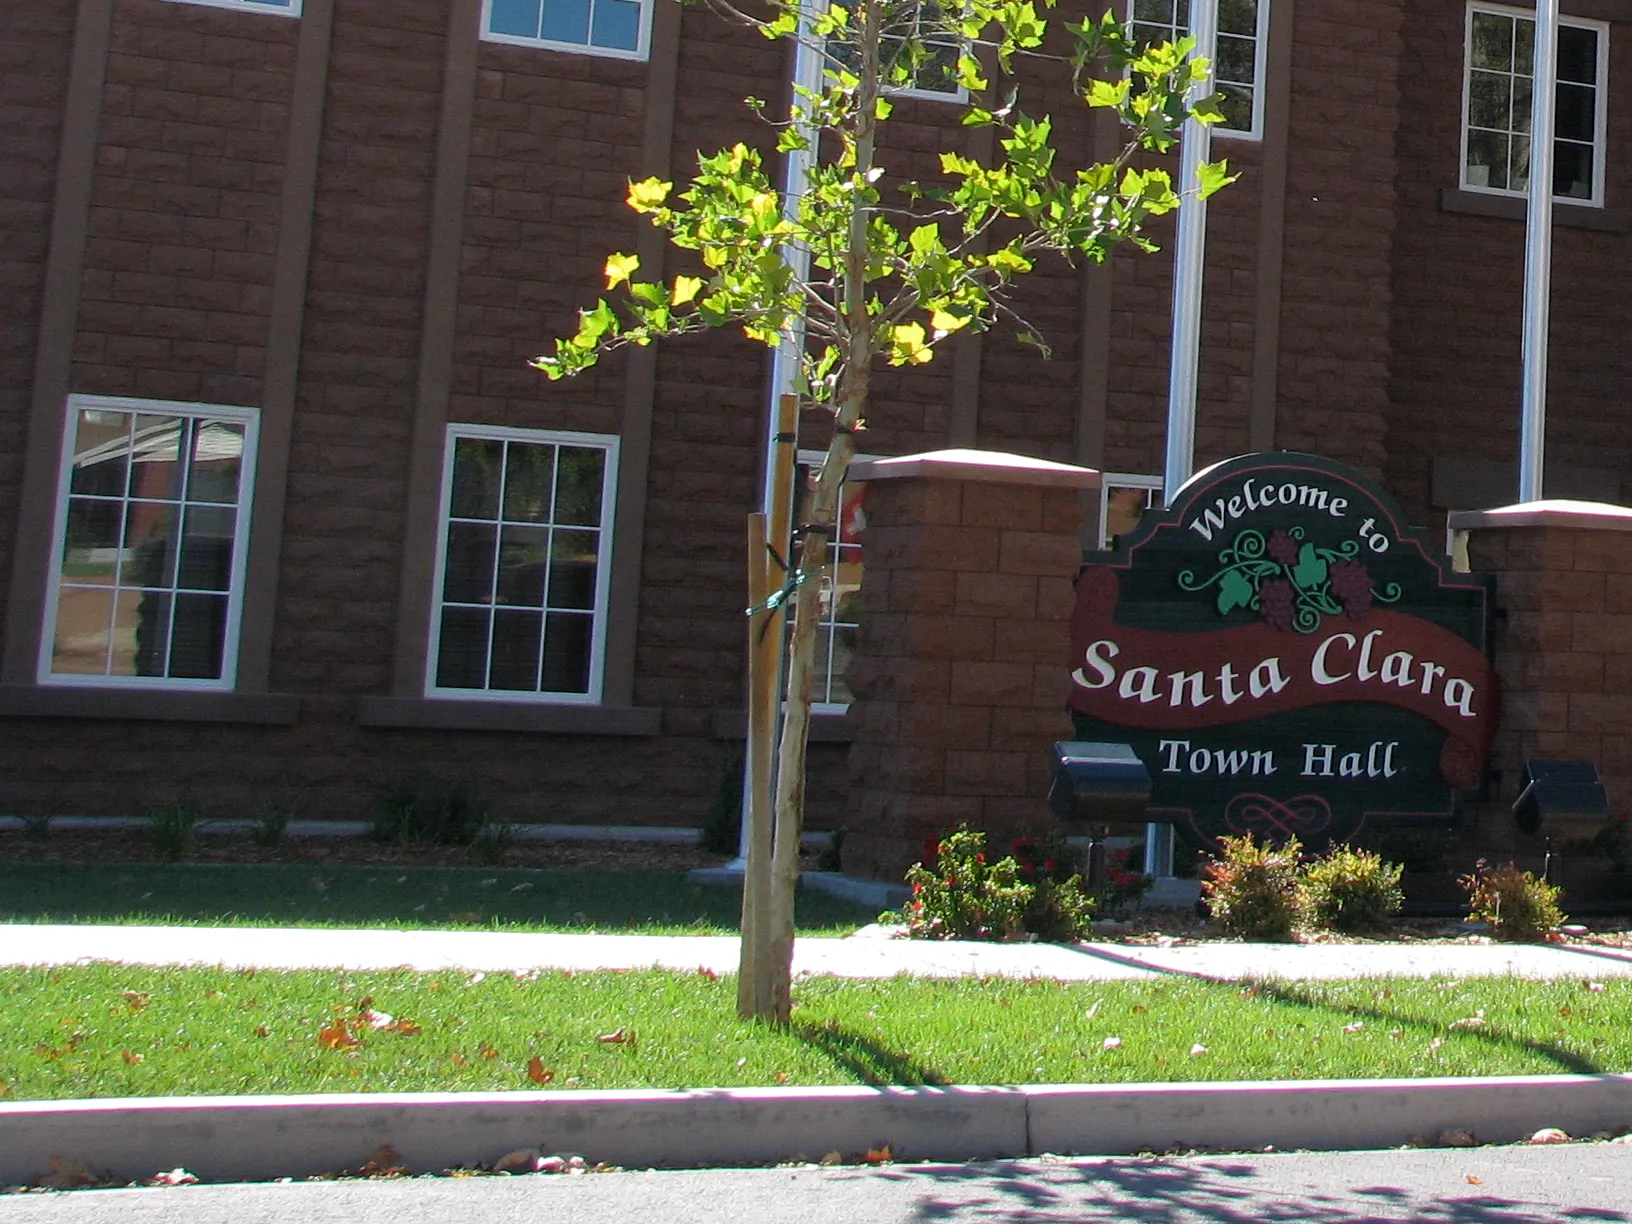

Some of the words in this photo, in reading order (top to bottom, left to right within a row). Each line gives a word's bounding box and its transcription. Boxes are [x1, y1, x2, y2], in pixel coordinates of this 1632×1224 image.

[1188, 478, 1349, 542] Welcome
[1357, 517, 1390, 554] to
[1071, 639, 1292, 708] Santa
[1310, 628, 1478, 718] Clara
[1158, 738, 1279, 775] Town
[1300, 740, 1401, 778] Hall
